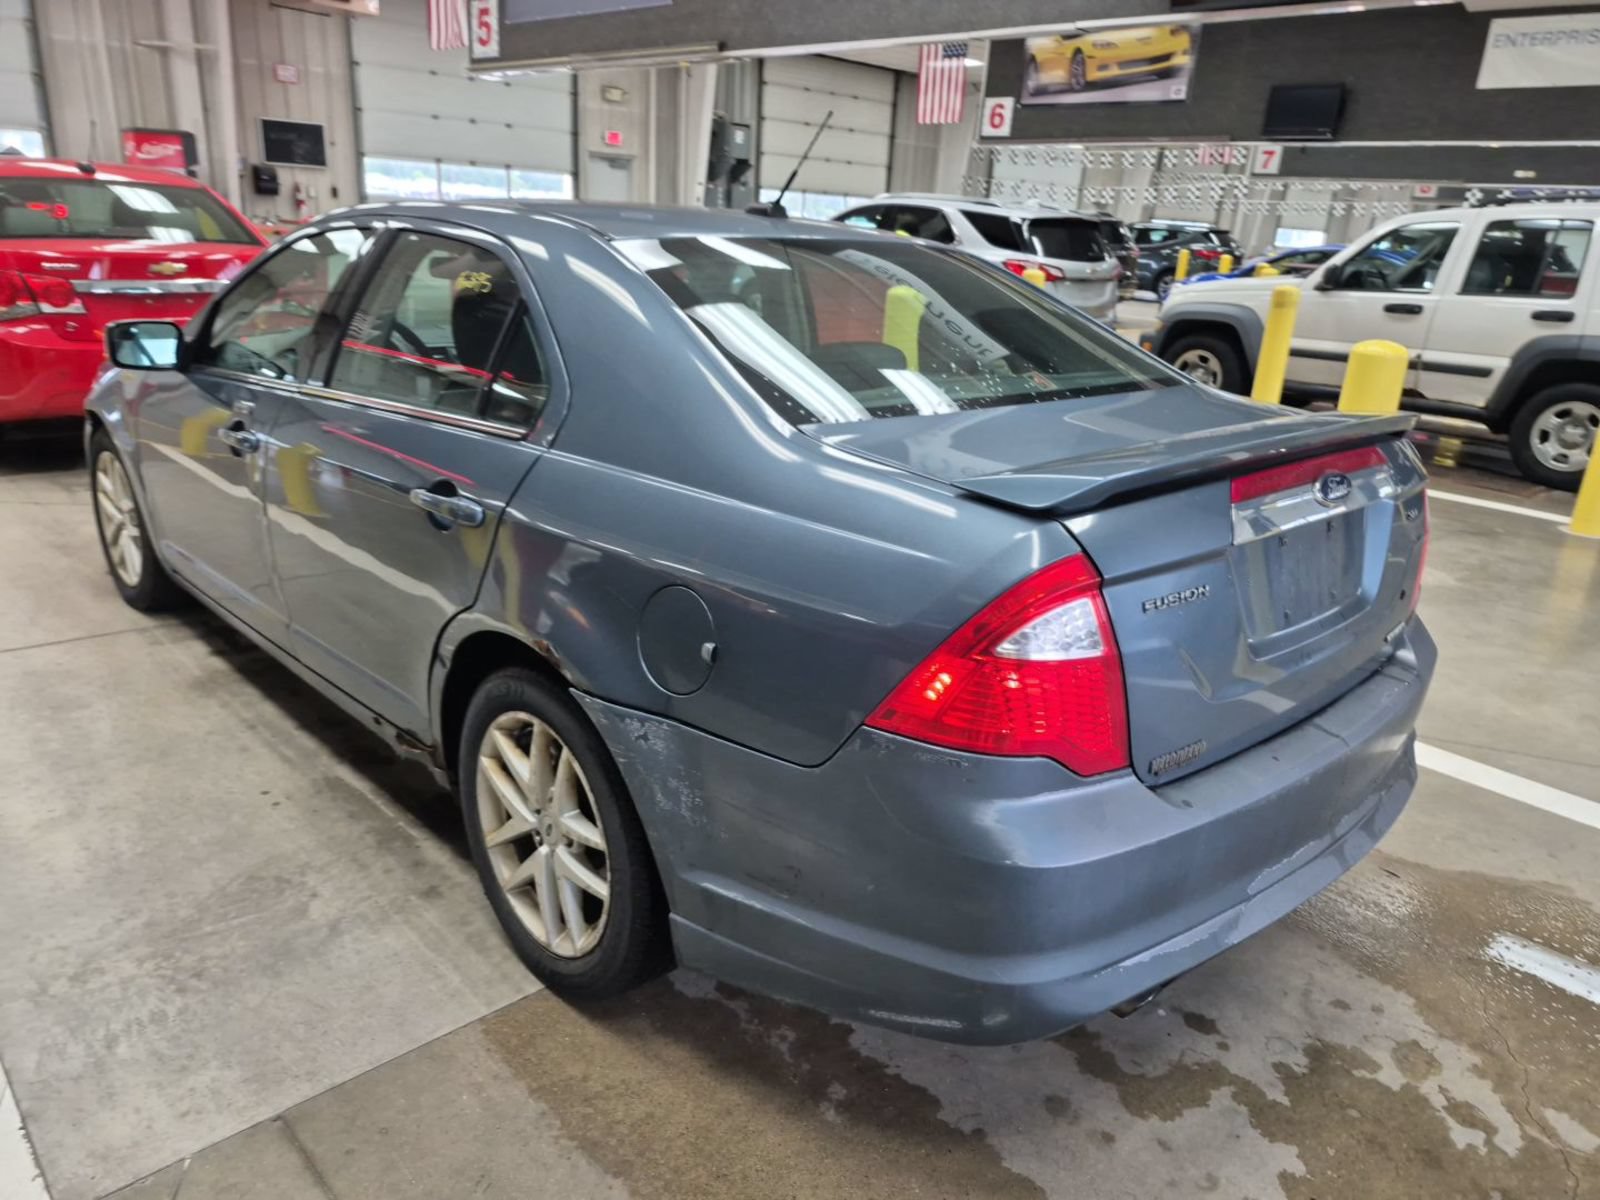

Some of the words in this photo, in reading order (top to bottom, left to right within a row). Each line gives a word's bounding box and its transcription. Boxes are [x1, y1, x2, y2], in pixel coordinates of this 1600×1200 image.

[478, 7, 492, 47] 5
[990, 103, 1005, 130] 6
[1263, 149, 1278, 170] 7
[1141, 584, 1210, 614] FUSION
